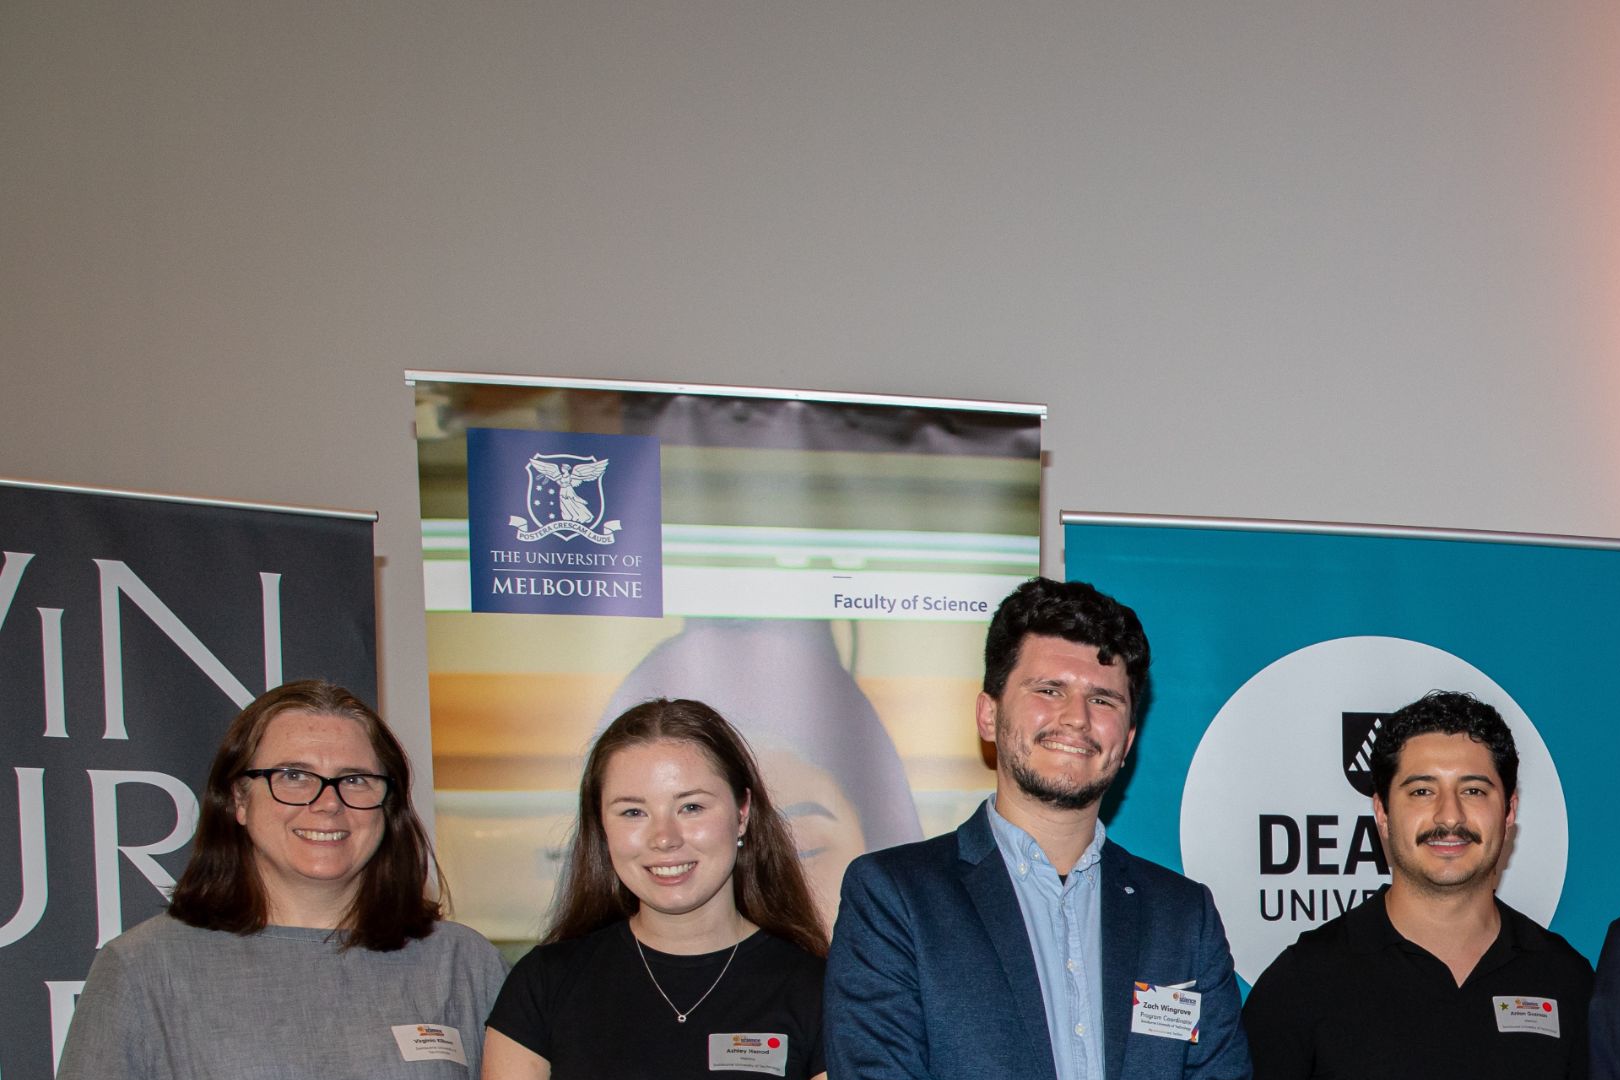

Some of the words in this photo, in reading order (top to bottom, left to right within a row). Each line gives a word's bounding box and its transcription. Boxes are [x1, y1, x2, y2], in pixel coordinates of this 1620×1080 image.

[518, 527, 552, 541] POSTERA
[553, 520, 588, 536] CRESCAM
[587, 530, 612, 543] LAUDE
[491, 550, 521, 563] THE
[525, 551, 618, 566] UNIVERSITY
[622, 554, 643, 567] OF
[491, 576, 643, 599] MELBOURNE
[834, 593, 896, 613] Faculty
[901, 594, 919, 611] of
[922, 596, 988, 612] Science
[0, 551, 283, 740] IN
[1143, 1002, 1159, 1010] Zach
